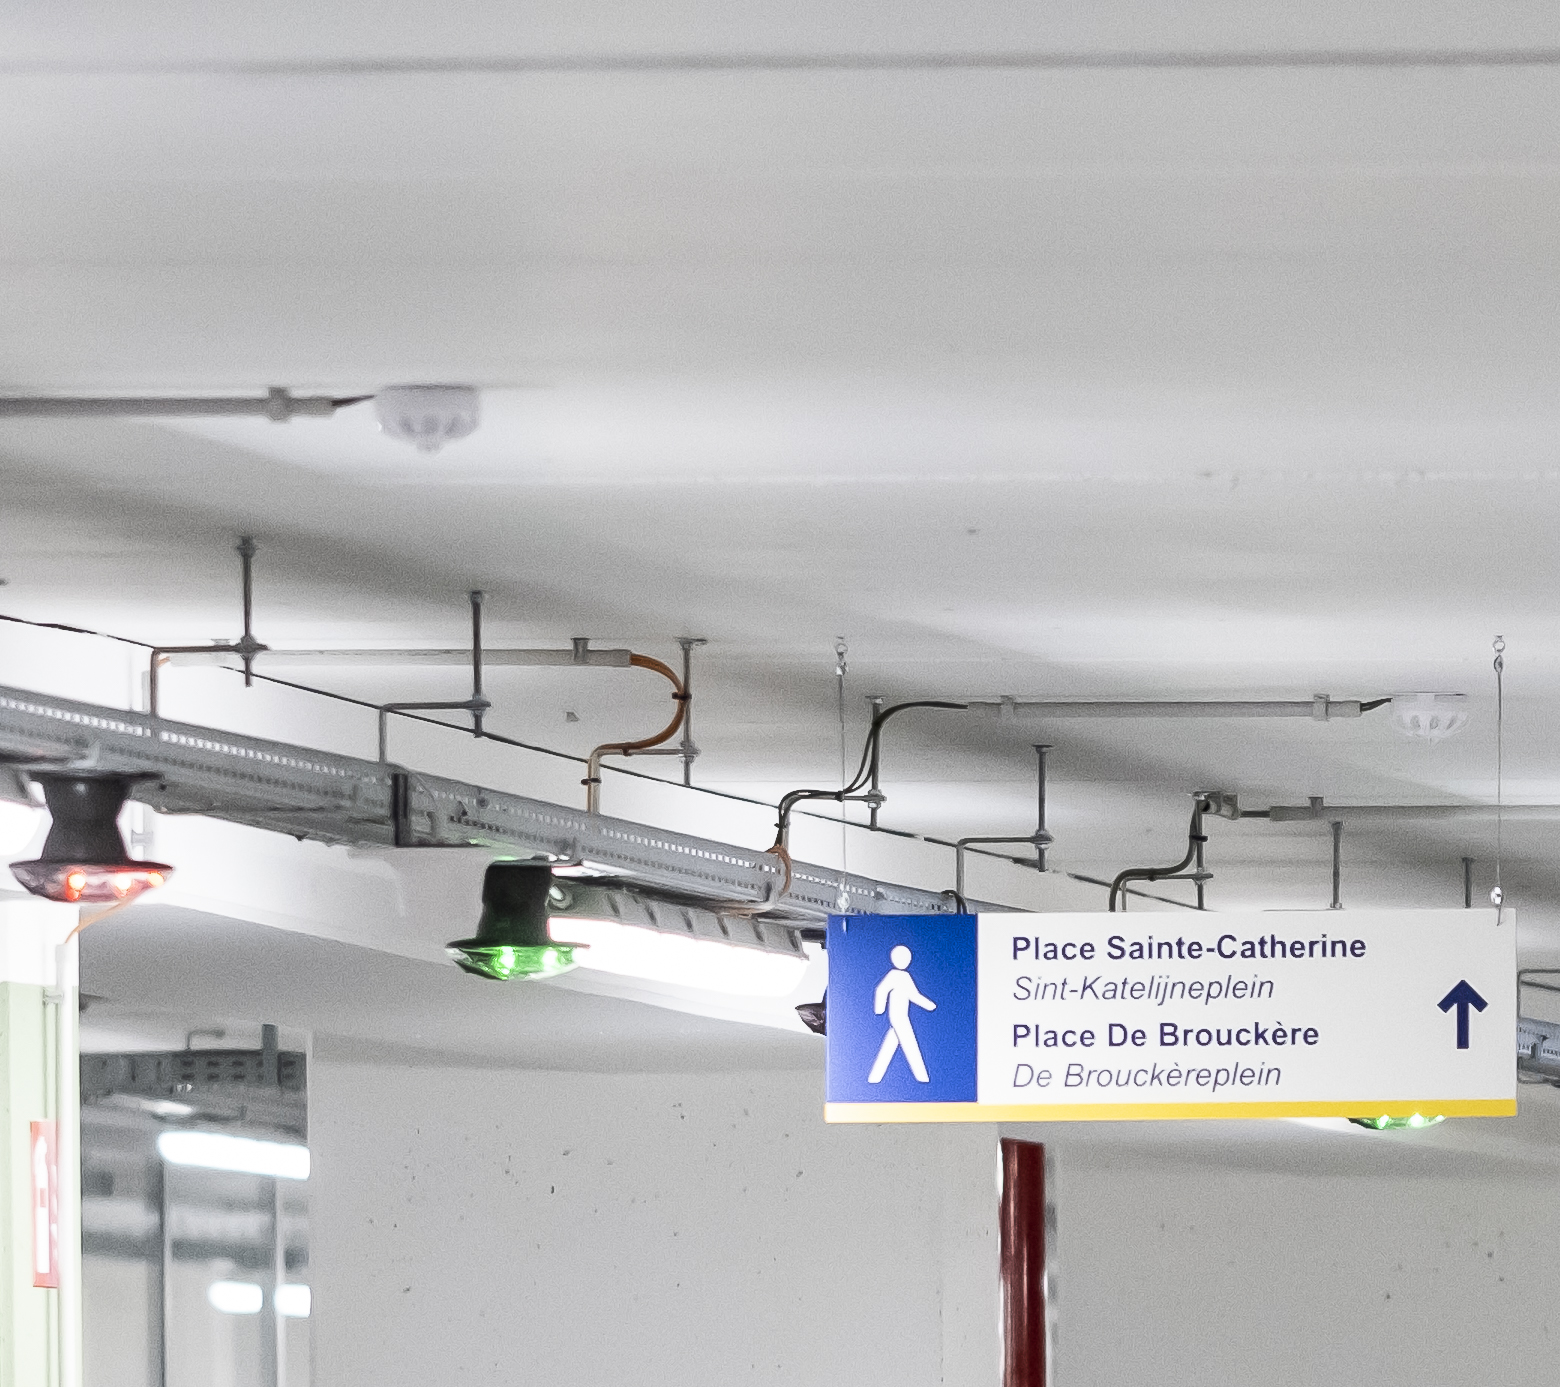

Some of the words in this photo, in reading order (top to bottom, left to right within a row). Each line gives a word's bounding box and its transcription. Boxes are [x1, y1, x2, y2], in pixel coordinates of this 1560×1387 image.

[1012, 936, 1096, 961] Place
[1105, 933, 1367, 960] Sainte-Catherine
[1012, 974, 1276, 1006] Sint-Katelijneplein
[1012, 1023, 1096, 1048] Place
[1107, 1022, 1148, 1048] De
[1158, 1020, 1320, 1047] Brouckère
[1012, 1063, 1053, 1088] De
[1063, 1060, 1282, 1093] Brouckèreplein
